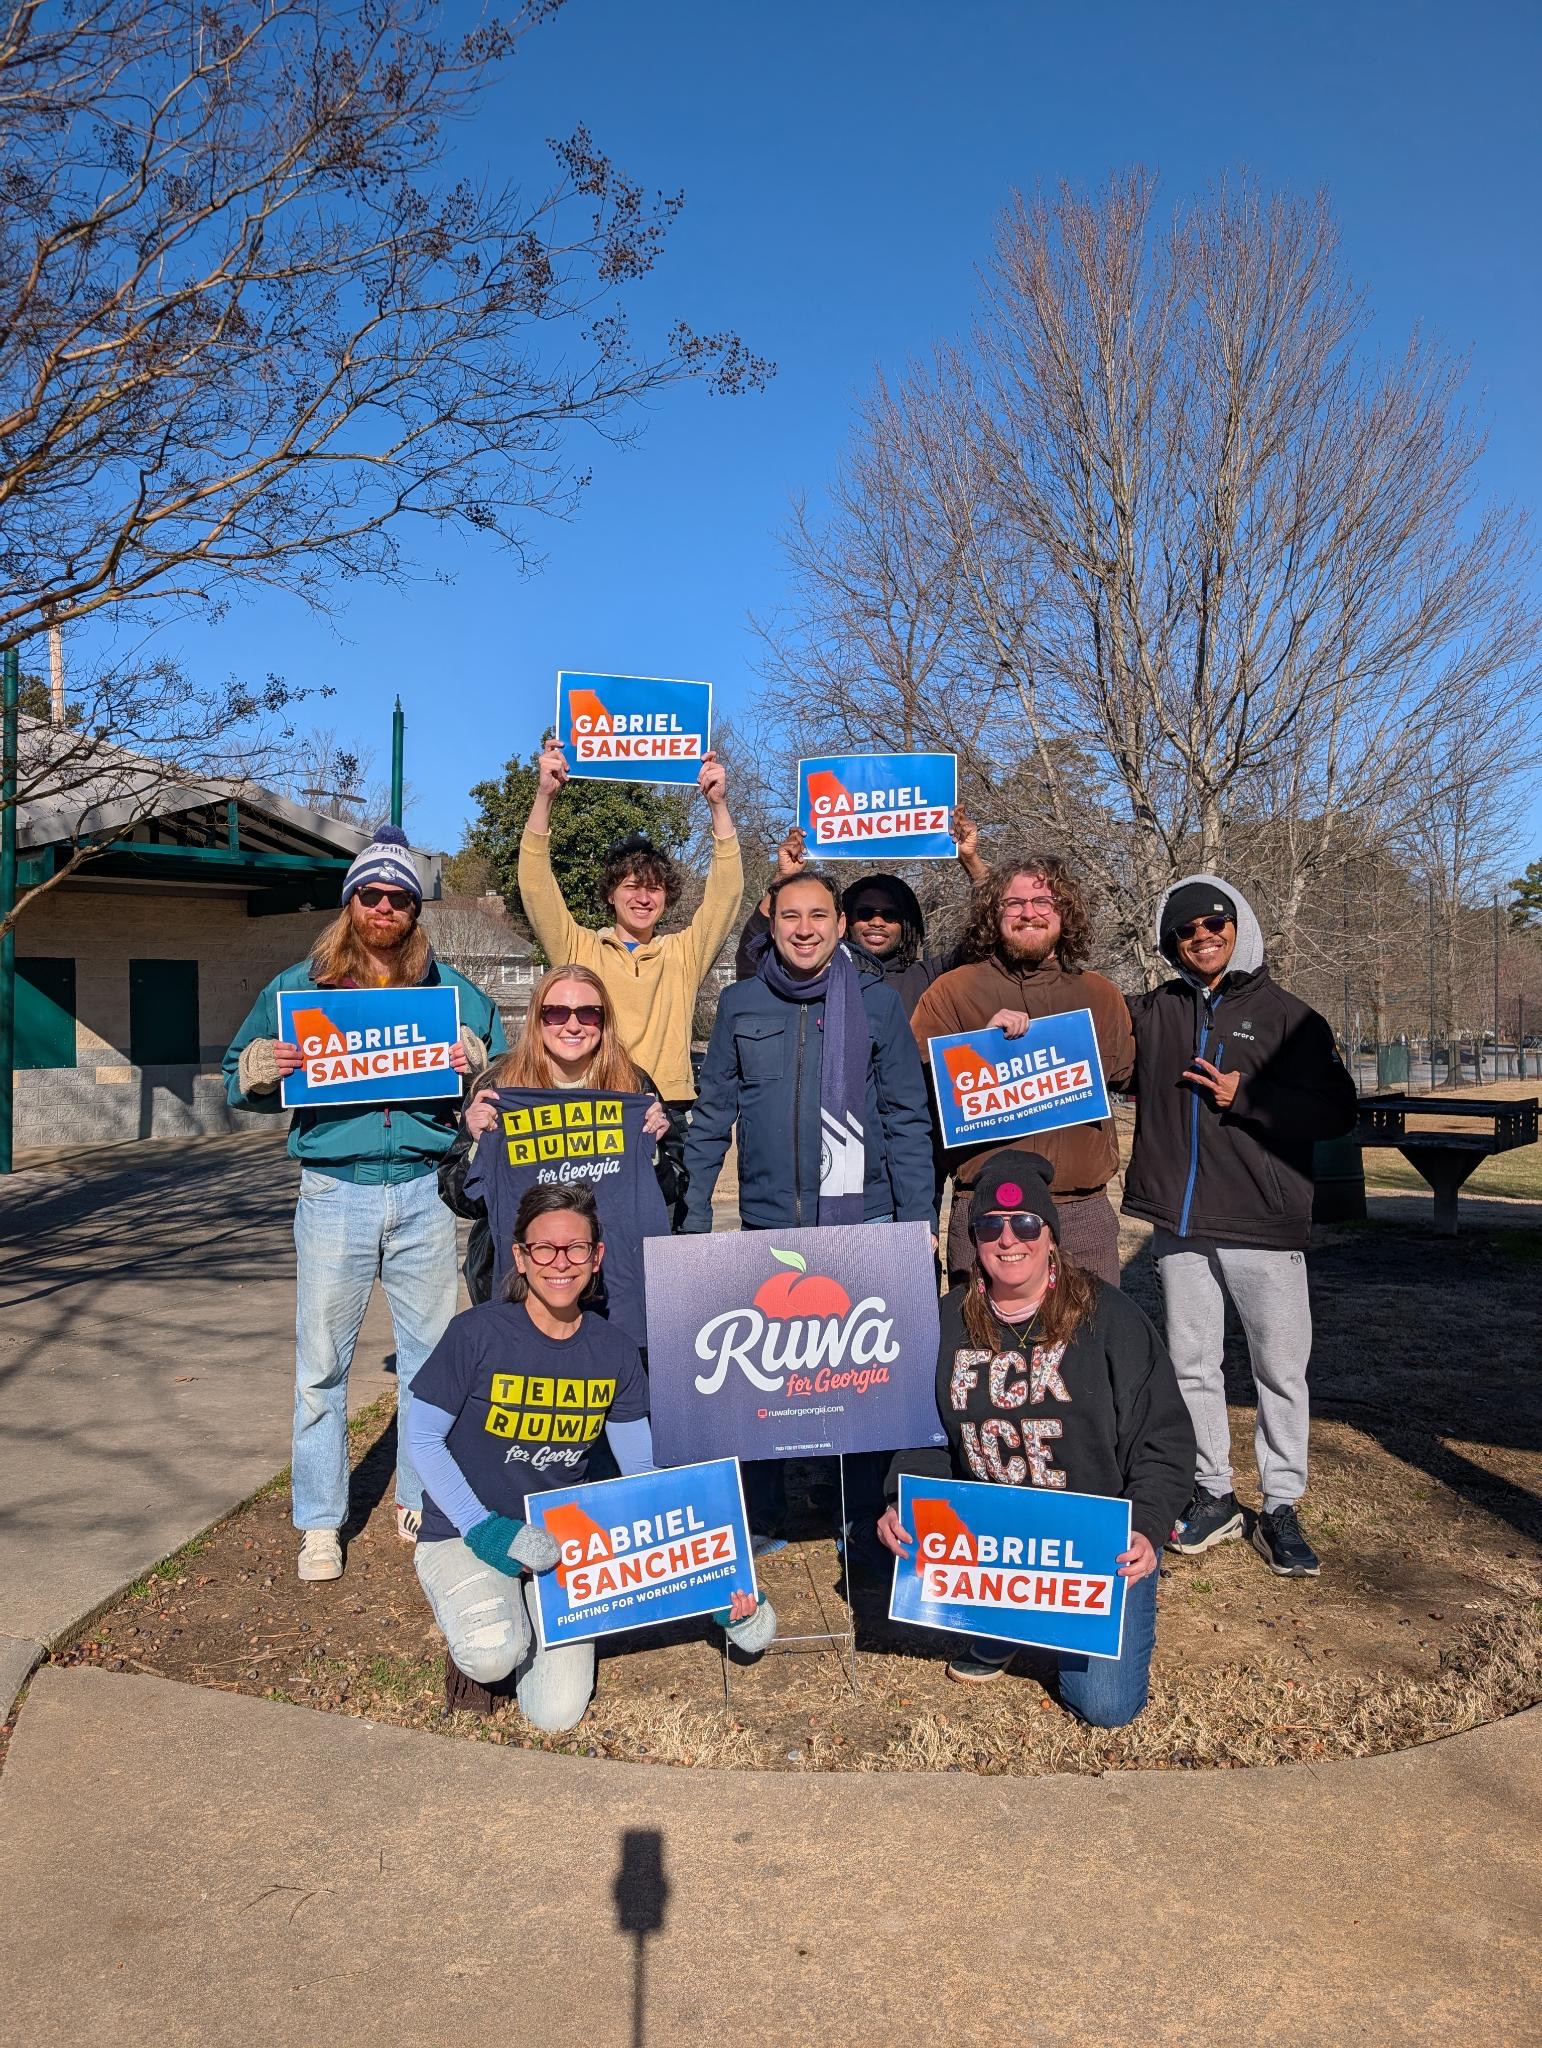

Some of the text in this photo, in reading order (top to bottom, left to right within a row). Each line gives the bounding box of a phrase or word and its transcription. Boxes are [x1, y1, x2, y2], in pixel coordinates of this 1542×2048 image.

[575, 713, 683, 734] GABRIEL
[580, 737, 697, 758] SANCHEZ
[814, 786, 928, 815] GABRIEL
[820, 810, 944, 840] SANCHEZ
[303, 1023, 427, 1057] GABRIEL
[311, 1046, 445, 1083] SANCHEZ
[955, 1045, 1065, 1093] GABRIEL
[966, 1066, 1088, 1115] SANCHEZ
[508, 1105, 618, 1131] TEAM
[955, 1089, 1093, 1134] FIGHTING FOR WORKING FAMILIES
[515, 1134, 619, 1160] RUWA
[537, 1157, 621, 1185] for Georgia
[694, 1296, 901, 1395] Ruwa
[499, 1378, 610, 1403] TEAM
[786, 1364, 890, 1397] for Georgia
[950, 1341, 1072, 1411] FCK
[492, 1412, 601, 1438] RUWA
[768, 1404, 845, 1418] ruwaforgeorgia.com
[504, 1445, 530, 1464] for
[960, 1418, 1067, 1488] ICE
[560, 1505, 705, 1567] GABRIEL
[922, 1532, 1083, 1568] GABRIEL
[572, 1531, 731, 1601] SANCHEZ
[557, 1565, 737, 1627] FIGHTING FOR WORKING FAMILIES
[929, 1570, 1107, 1609] SANCHEZ
